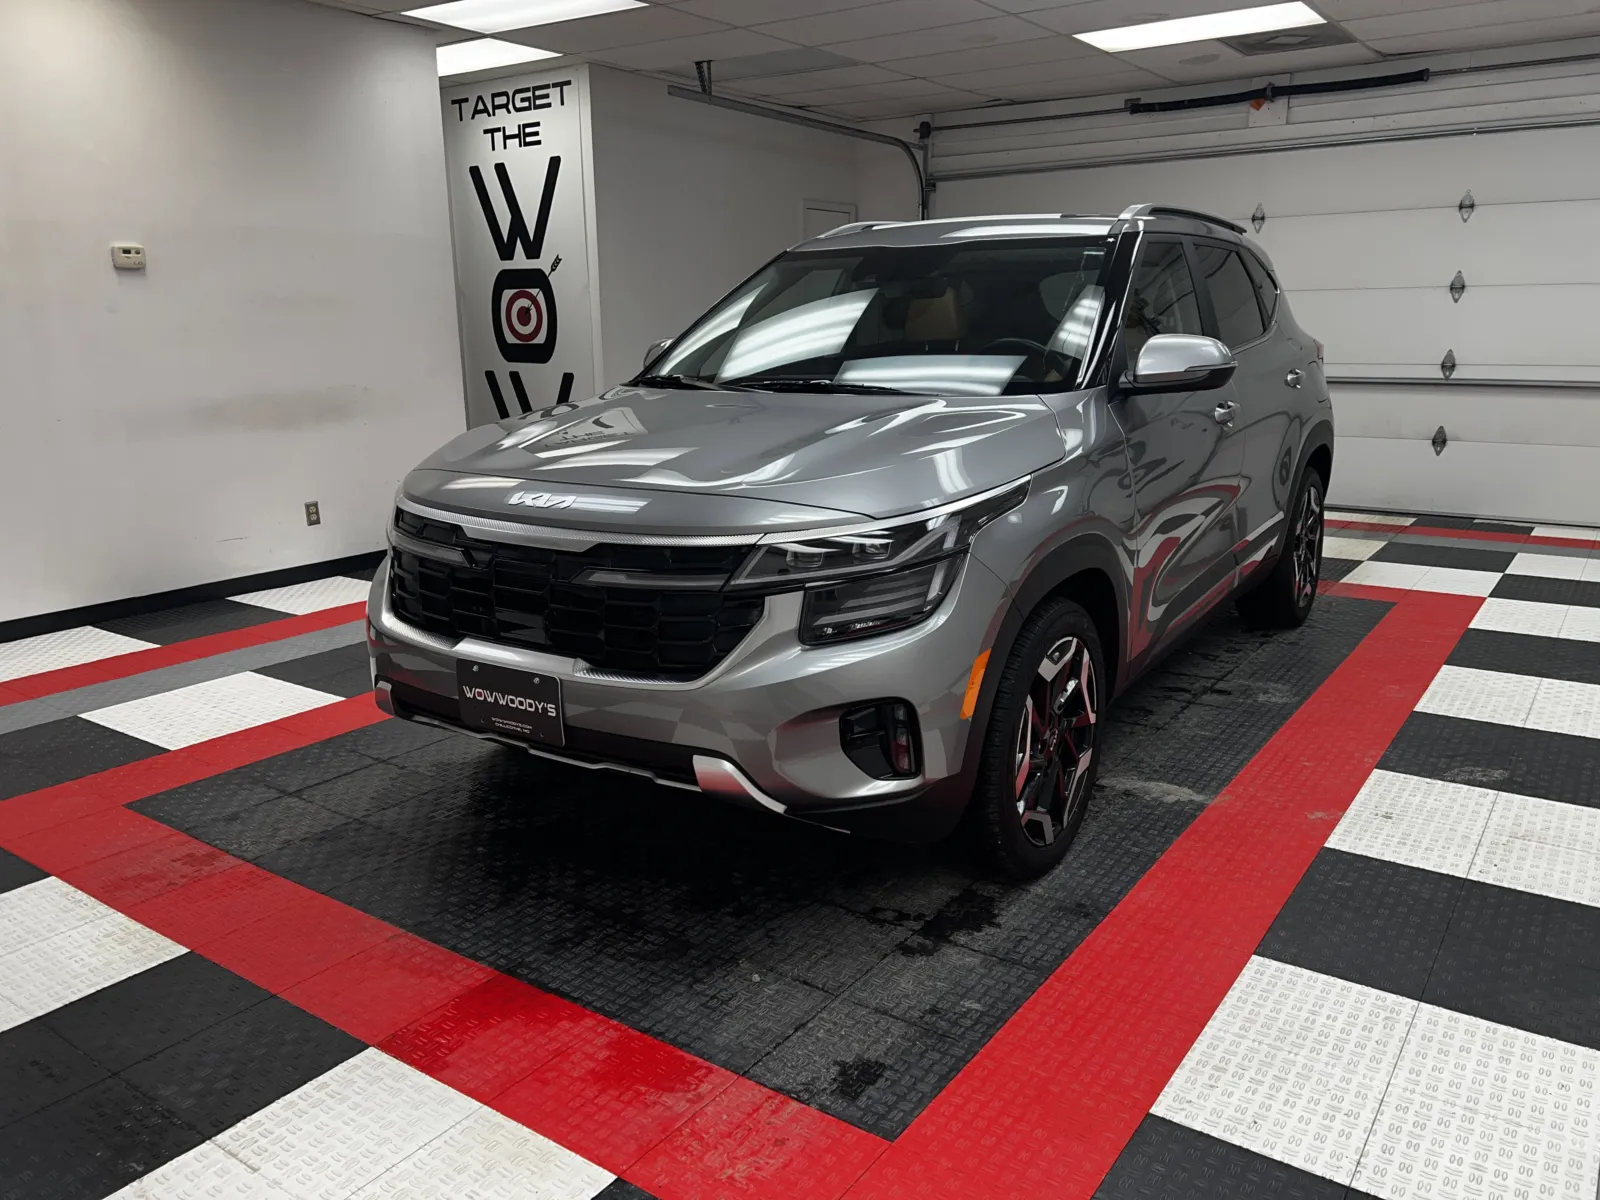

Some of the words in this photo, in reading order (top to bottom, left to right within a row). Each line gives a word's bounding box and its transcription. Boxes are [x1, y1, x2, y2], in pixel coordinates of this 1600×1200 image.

[451, 80, 572, 122] TARGET
[483, 121, 542, 151] THE
[508, 491, 577, 510] KIA
[462, 685, 557, 717] WOWWOODY'S
